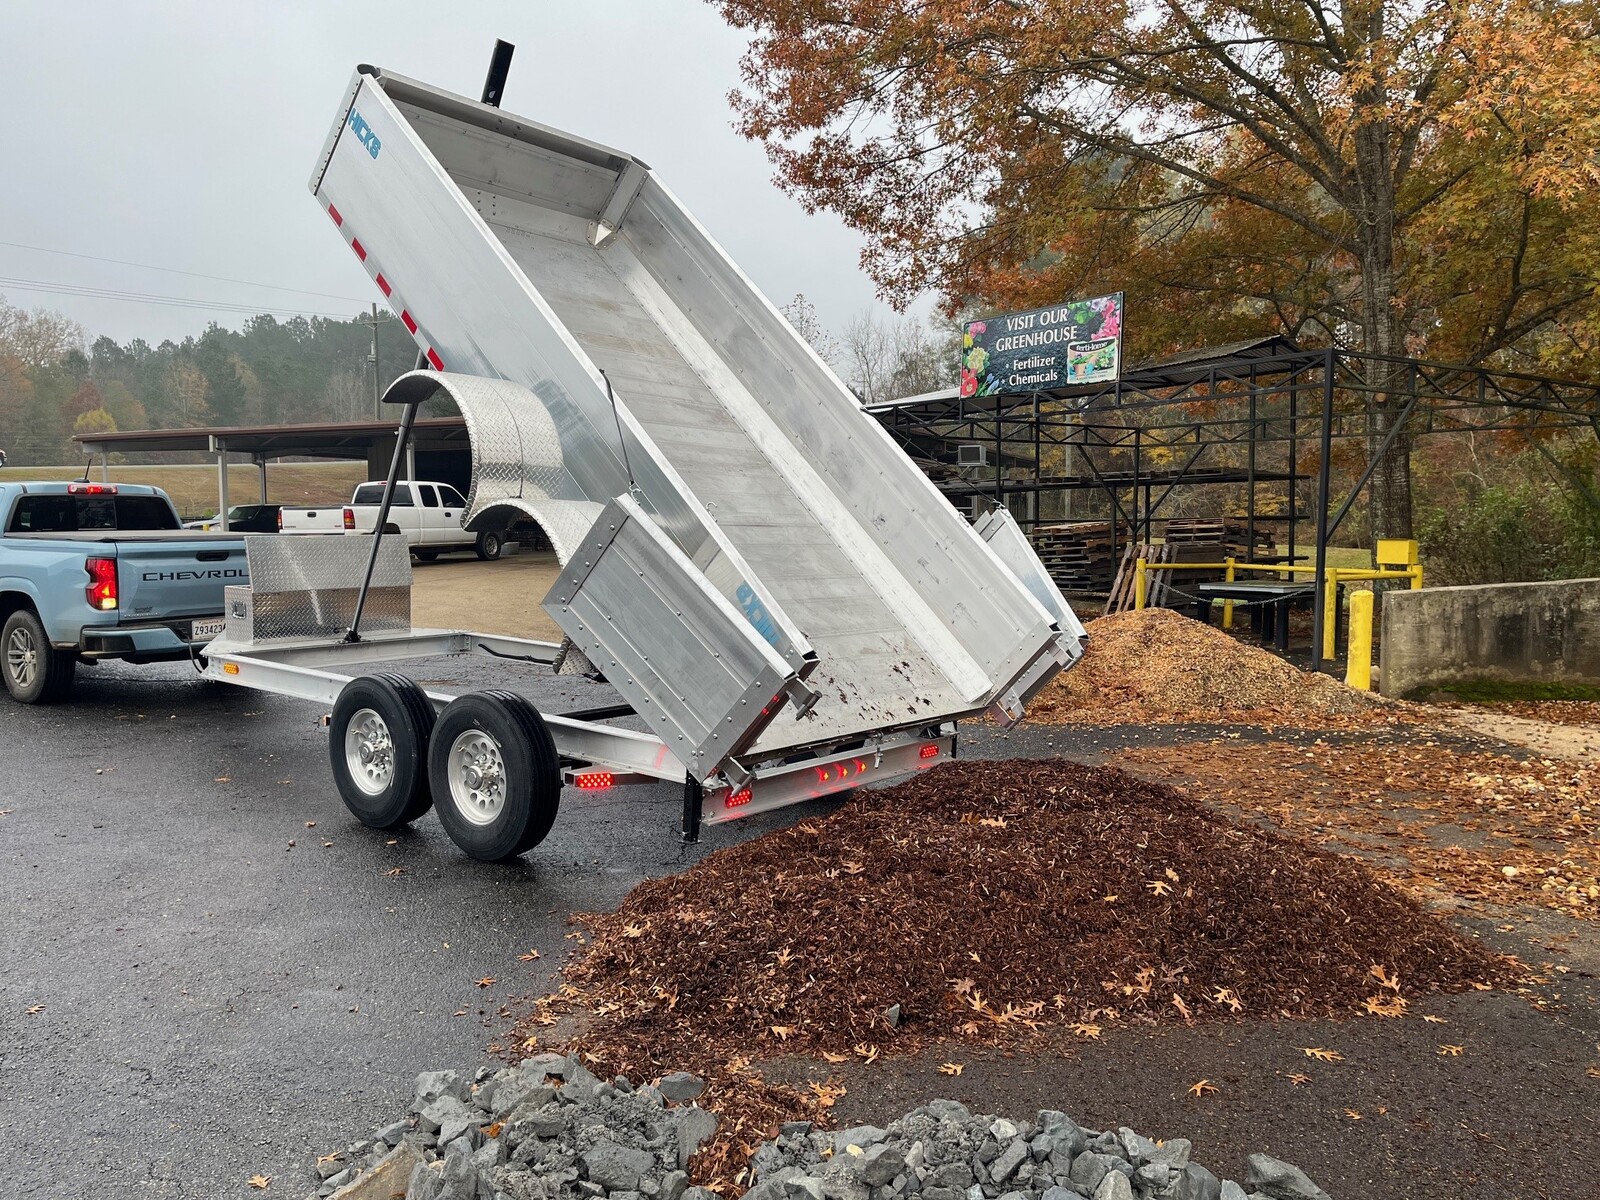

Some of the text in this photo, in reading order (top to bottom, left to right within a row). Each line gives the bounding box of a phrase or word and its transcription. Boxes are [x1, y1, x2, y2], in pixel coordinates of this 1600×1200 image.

[348, 108, 381, 159] HICKS
[1007, 308, 1068, 331] VISIT OUR
[996, 326, 1078, 352] GREENHOUSE
[1013, 357, 1055, 371] Fertilizer
[1009, 371, 1058, 386] Chemicals
[142, 569, 249, 581] CHEVROL
